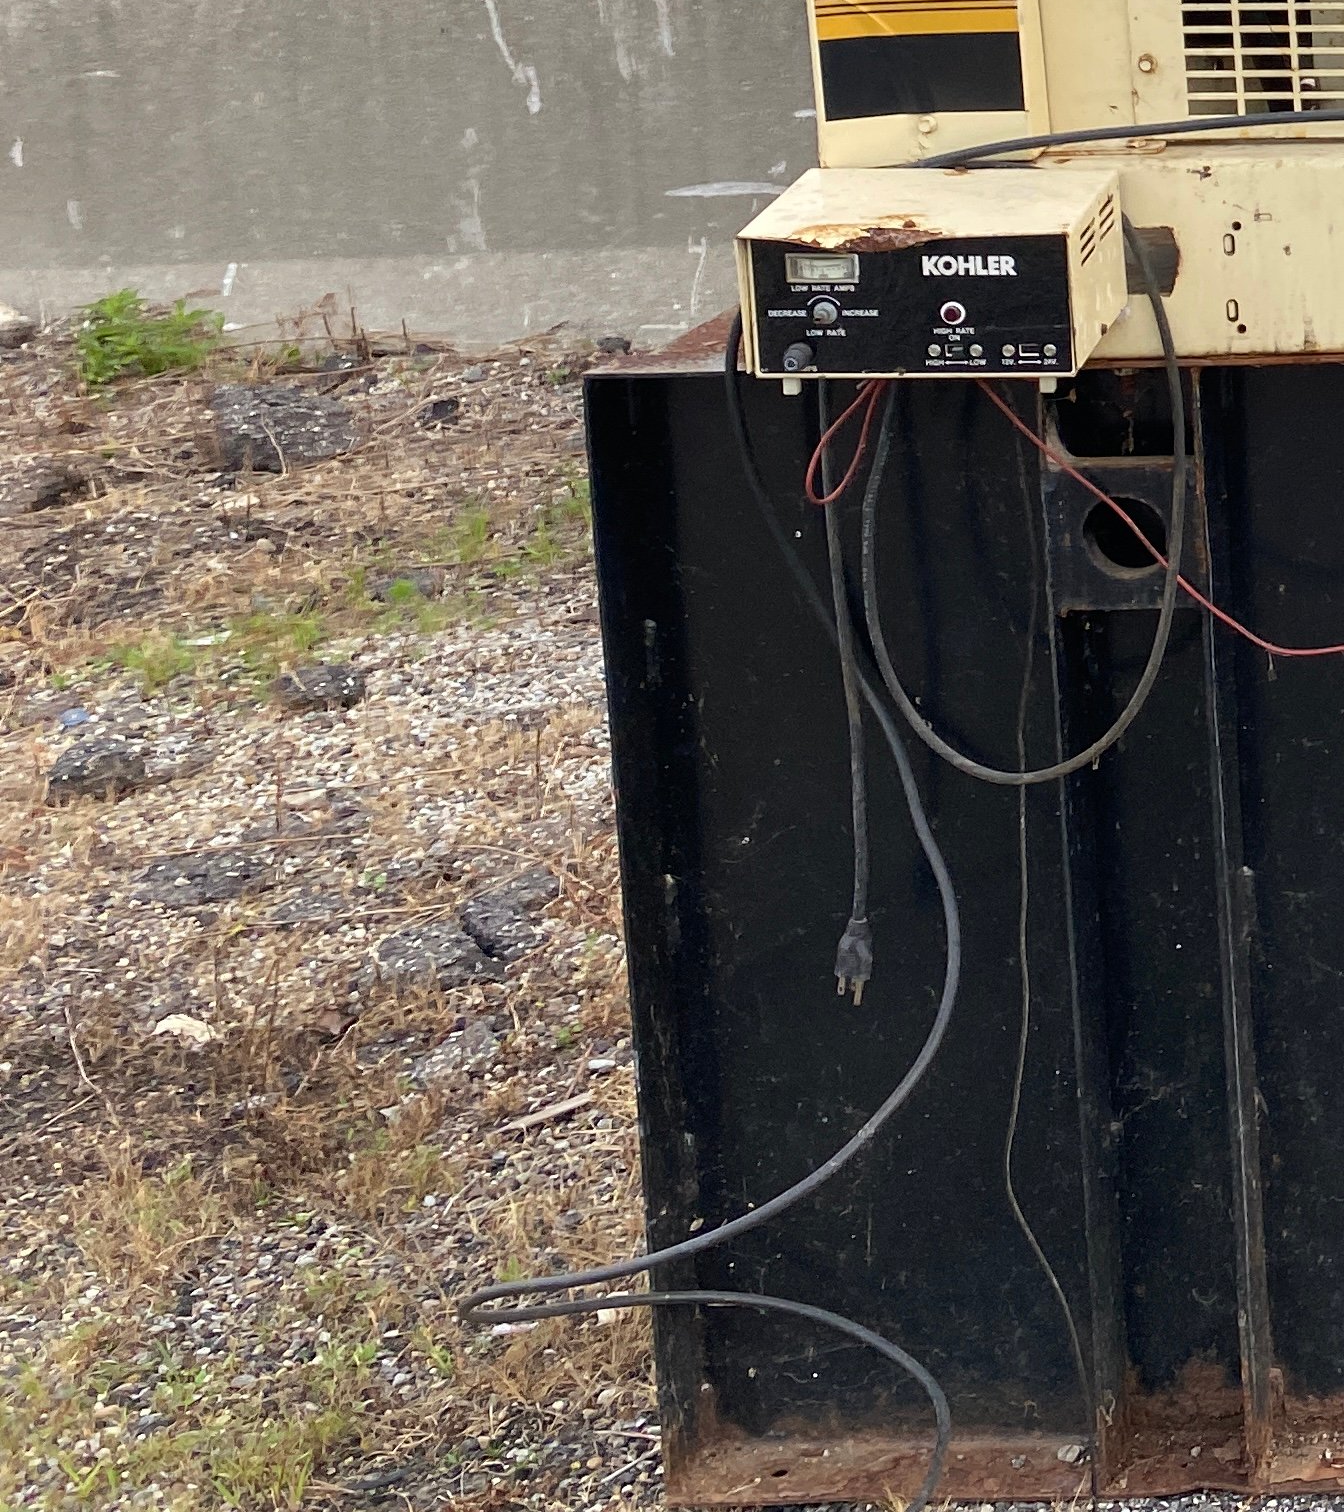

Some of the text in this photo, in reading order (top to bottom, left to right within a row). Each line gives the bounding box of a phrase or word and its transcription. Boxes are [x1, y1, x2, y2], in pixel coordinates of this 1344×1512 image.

[921, 255, 1018, 276] KOHLER
[790, 284, 809, 292] LOW
[811, 284, 831, 292] RATE
[767, 309, 808, 317] DECREASE
[841, 309, 879, 317] INCREASE
[805, 329, 847, 337] LOW RATE
[933, 327, 975, 335] HIGH RATE
